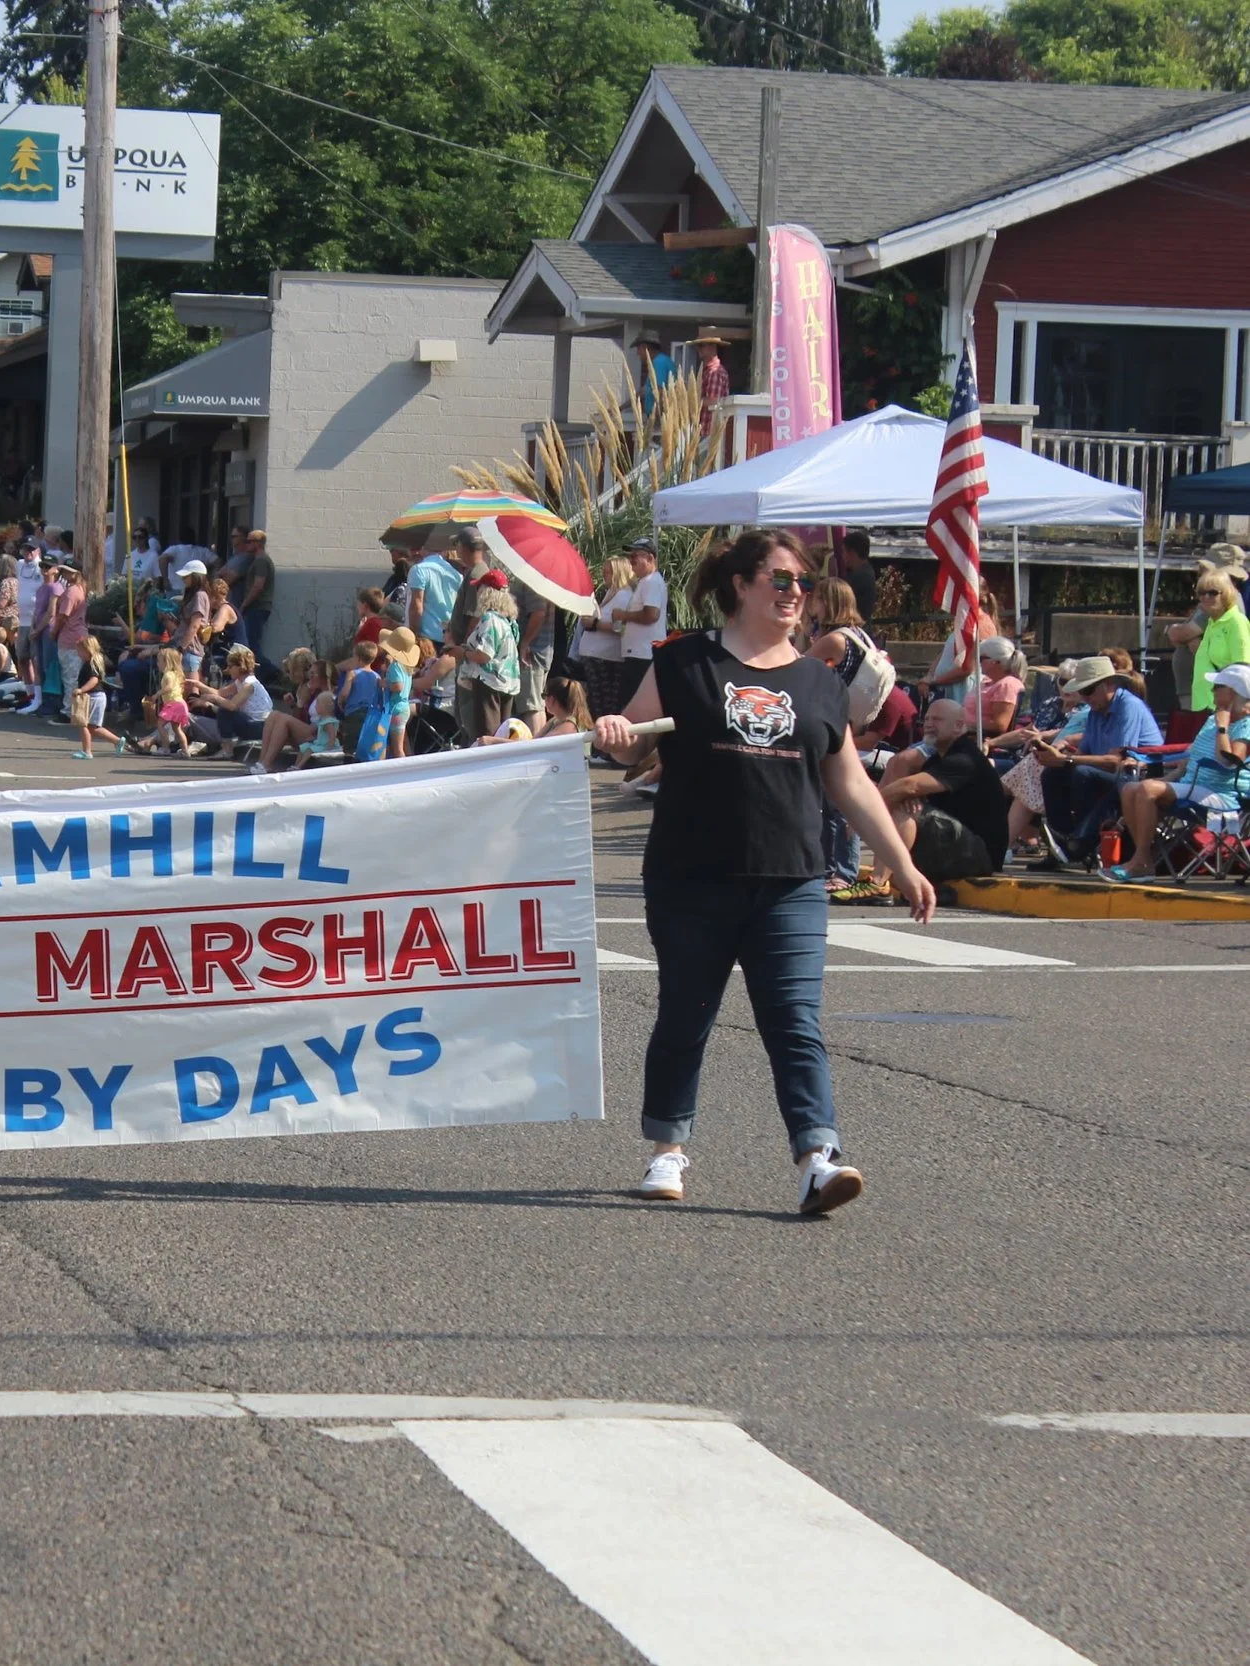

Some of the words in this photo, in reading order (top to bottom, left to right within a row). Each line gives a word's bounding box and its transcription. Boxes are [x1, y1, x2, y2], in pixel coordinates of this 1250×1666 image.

[67, 145, 187, 169] UPQUA
[796, 260, 831, 421] HAIR
[177, 394, 227, 406] UMPQUA
[230, 396, 261, 406] BANK
[772, 347, 792, 441] COLOR
[36, 899, 574, 1002] MARSHALL
[174, 1007, 442, 1124] DAYS
